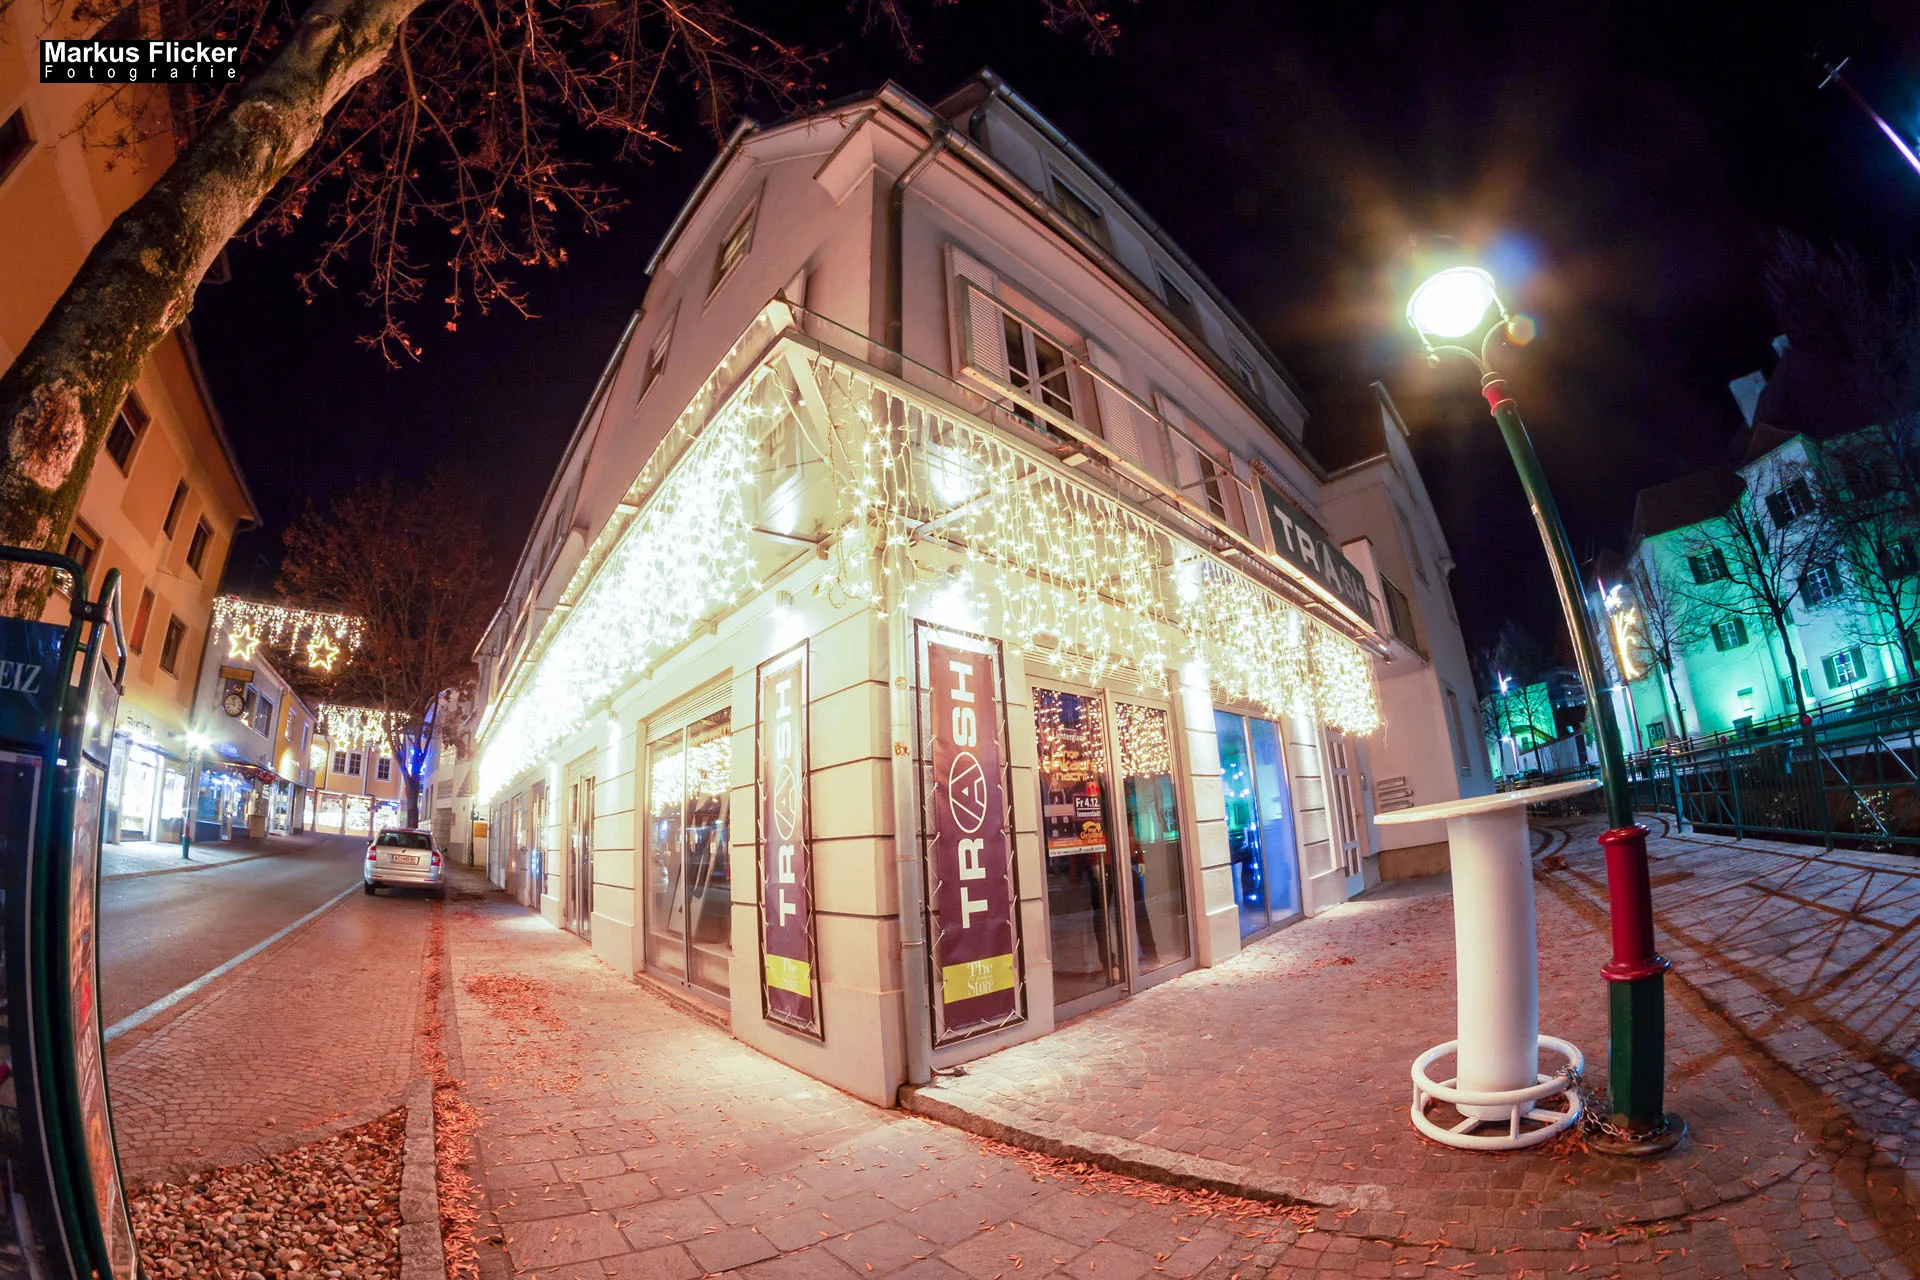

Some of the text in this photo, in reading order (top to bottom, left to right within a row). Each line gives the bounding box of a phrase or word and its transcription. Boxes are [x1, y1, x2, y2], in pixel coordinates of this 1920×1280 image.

[1273, 505, 1369, 614] TRASH
[773, 677, 797, 927] TRASH
[948, 660, 989, 929] TRASH
[1075, 797, 1084, 808] Fr
[966, 961, 993, 977] The
